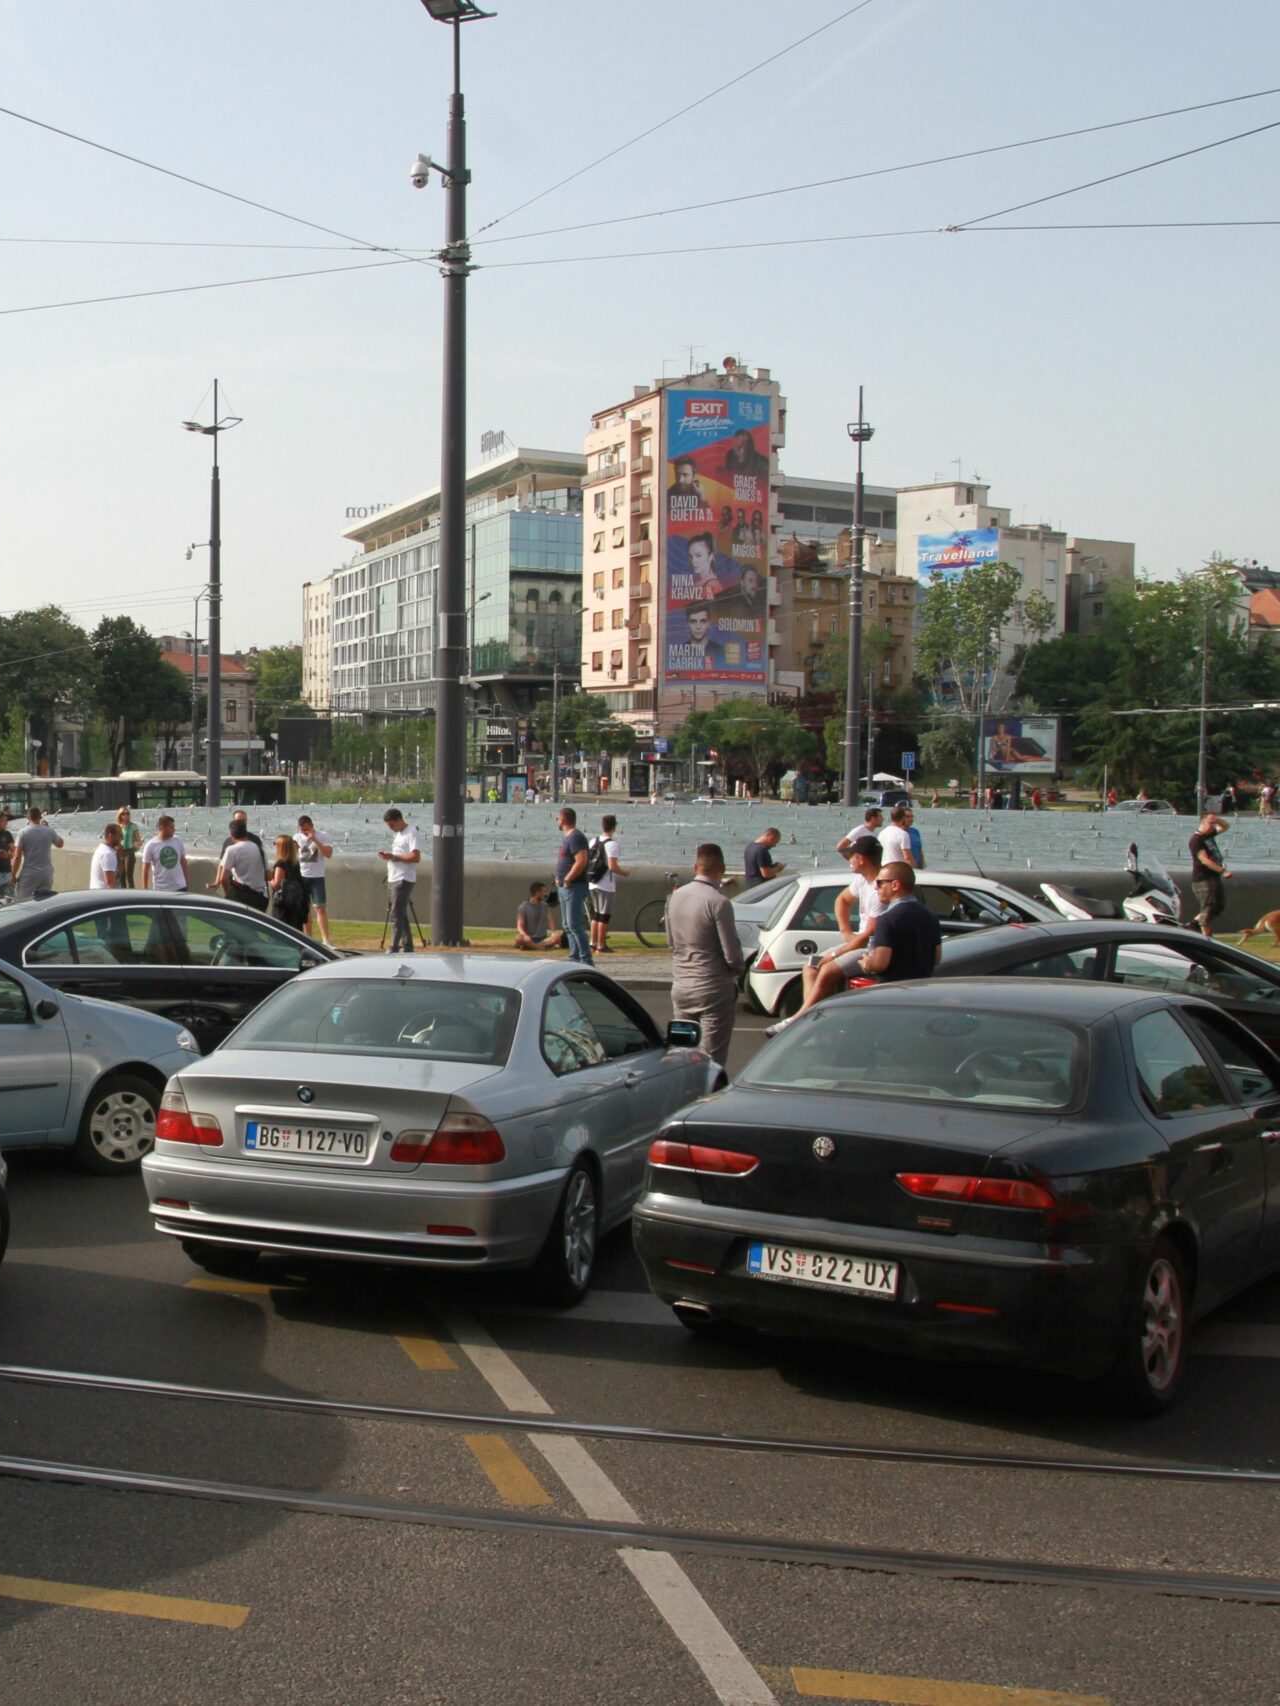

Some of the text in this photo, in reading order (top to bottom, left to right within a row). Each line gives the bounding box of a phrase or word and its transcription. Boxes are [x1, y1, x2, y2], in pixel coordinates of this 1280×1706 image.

[690, 402, 723, 414] EXIT
[677, 416, 734, 435] Freedom
[481, 430, 504, 453] Hilton
[733, 474, 757, 490] GRACE
[670, 495, 698, 508] DAVID
[735, 488, 756, 502] JONES
[670, 508, 705, 521] GUETTA
[732, 543, 756, 558] MIGOS
[920, 547, 994, 562] Travelland
[671, 574, 694, 587] NINA
[671, 586, 703, 600] KRAVIZ
[718, 617, 754, 633] SOLOMUN
[668, 644, 705, 657] MARTIN
[668, 656, 703, 671] GARRIX
[486, 725, 512, 736] Hilton
[260, 1126, 280, 1147] BG
[767, 1247, 793, 1273] VS
